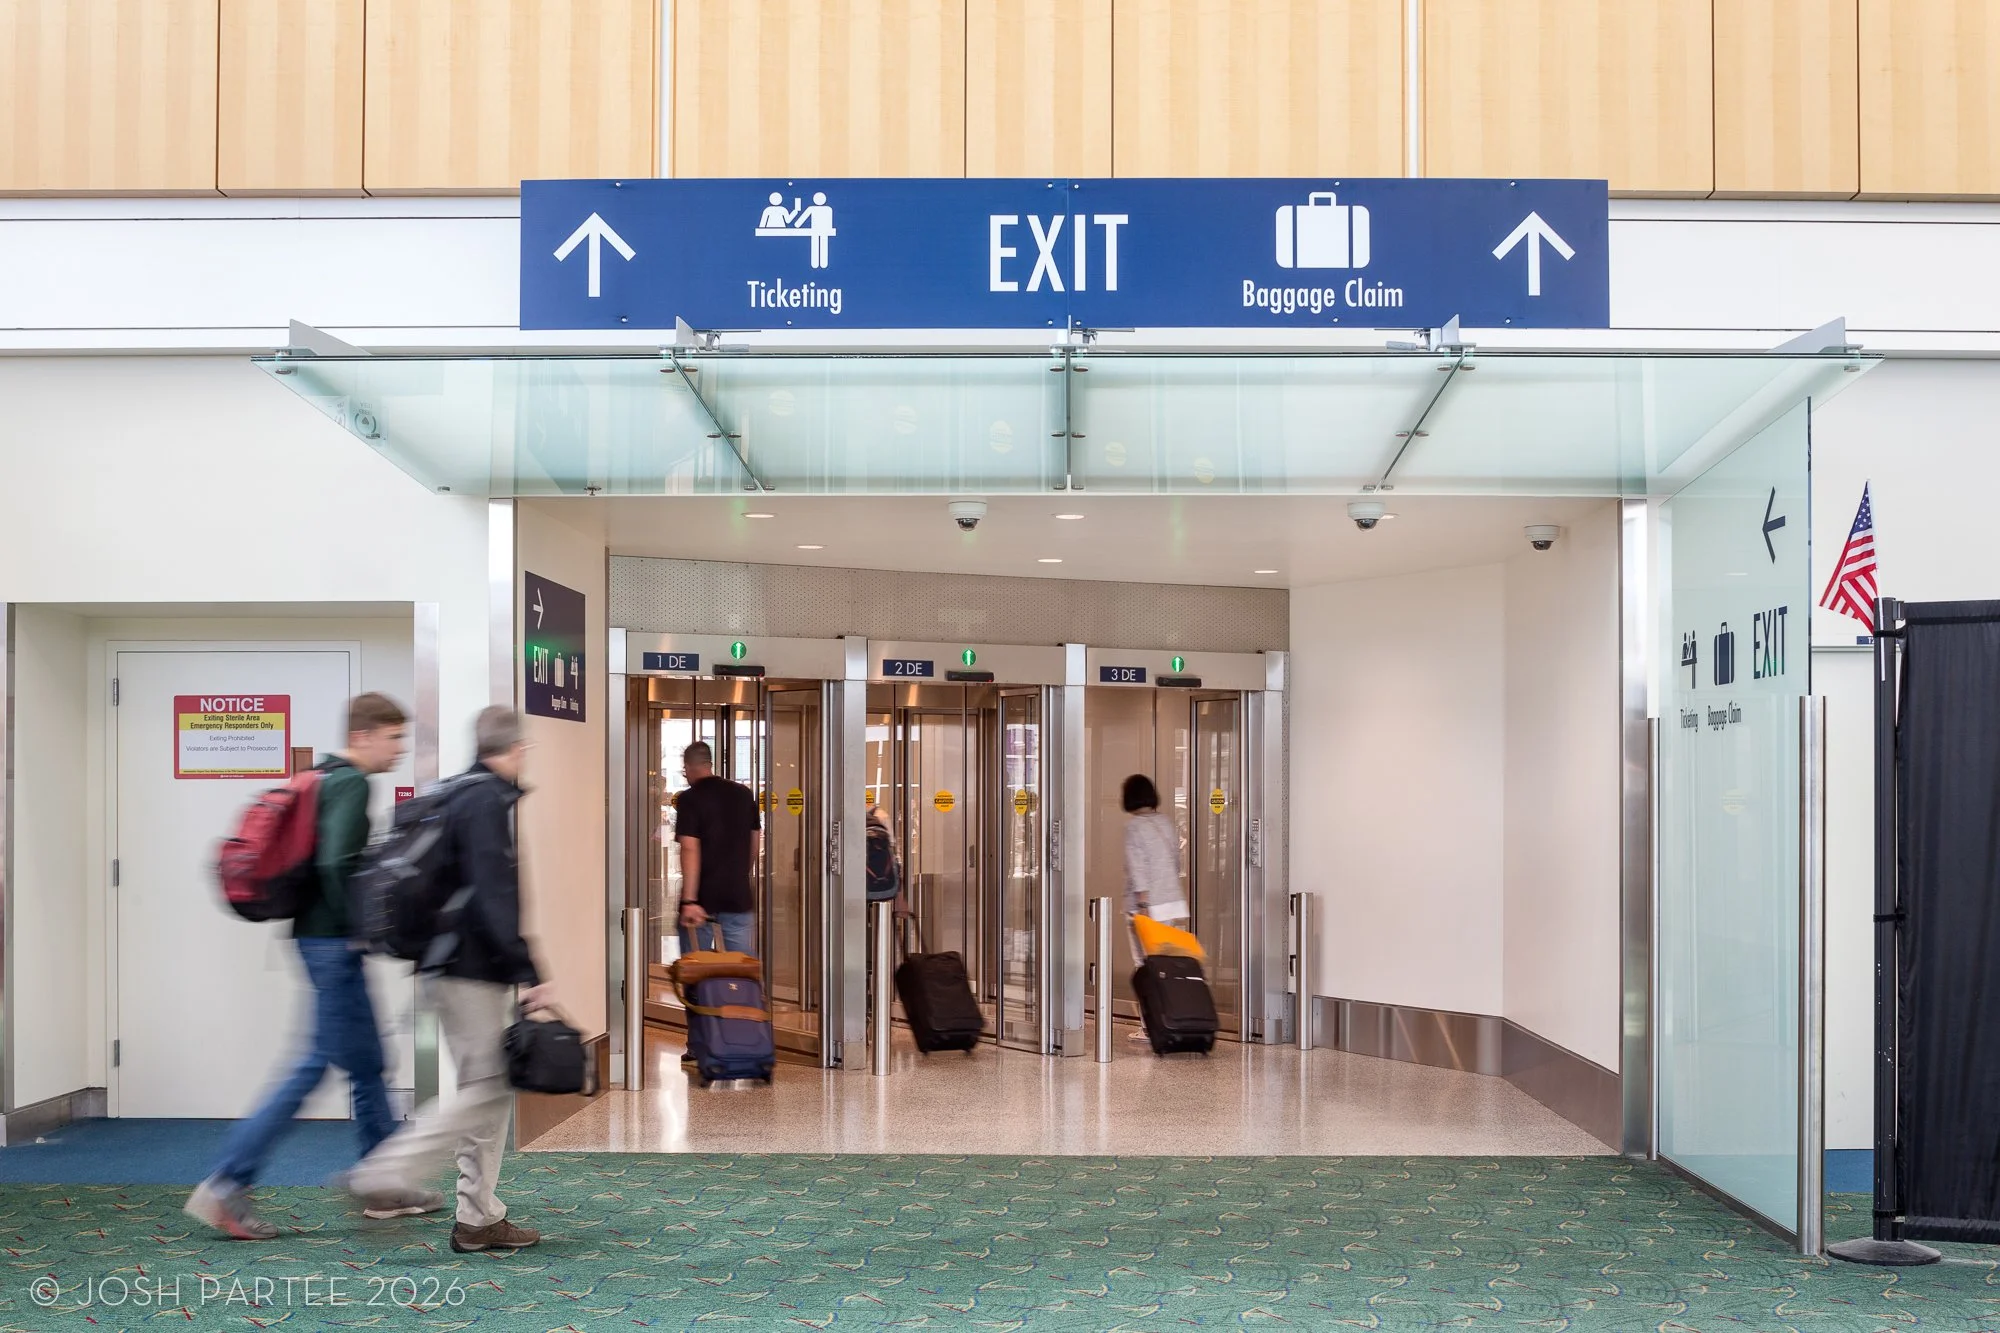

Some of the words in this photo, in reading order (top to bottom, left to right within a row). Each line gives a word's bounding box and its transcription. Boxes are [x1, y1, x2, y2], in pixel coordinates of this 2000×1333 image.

[990, 214, 1130, 292] EXIT
[747, 278, 842, 315] Ticketing
[1243, 279, 1336, 314] Baggage
[1344, 277, 1403, 307] Claim
[1753, 605, 1788, 680] EXIT
[534, 646, 549, 684] EXIT
[656, 656, 662, 668] 1
[669, 656, 686, 669] DE
[894, 662, 903, 675] 2
[906, 662, 923, 675] DE
[1111, 669, 1118, 681] 3
[1121, 669, 1136, 681] DE
[200, 697, 265, 712] NOTICE
[1707, 704, 1727, 731] Baggage
[1728, 699, 1741, 724] Claim
[190, 722, 223, 730] Emergency
[224, 722, 259, 730] Responders
[260, 722, 274, 730] Only
[204, 714, 224, 722] Exiting
